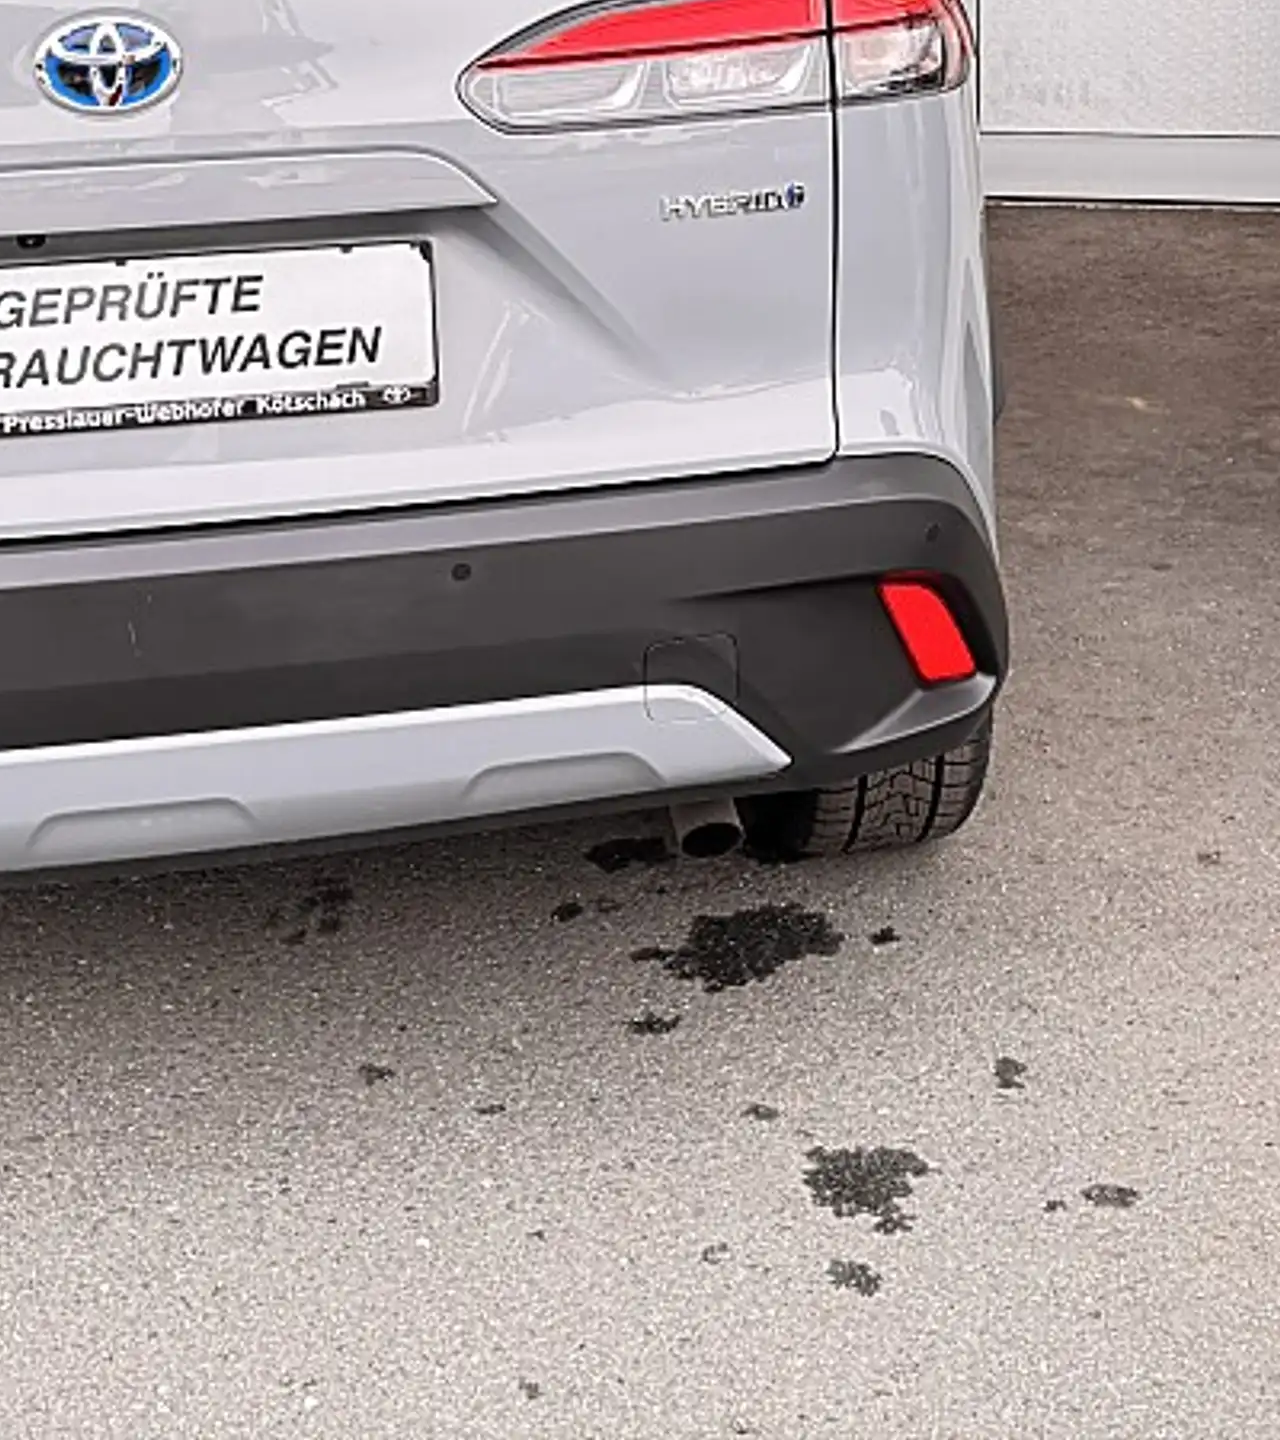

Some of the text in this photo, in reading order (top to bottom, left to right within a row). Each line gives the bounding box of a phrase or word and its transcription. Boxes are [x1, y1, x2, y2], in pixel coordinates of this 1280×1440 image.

[659, 188, 785, 222] HYBRID
[2, 398, 245, 434] Presslauer-Webhofer
[256, 389, 367, 415] Kötschach
